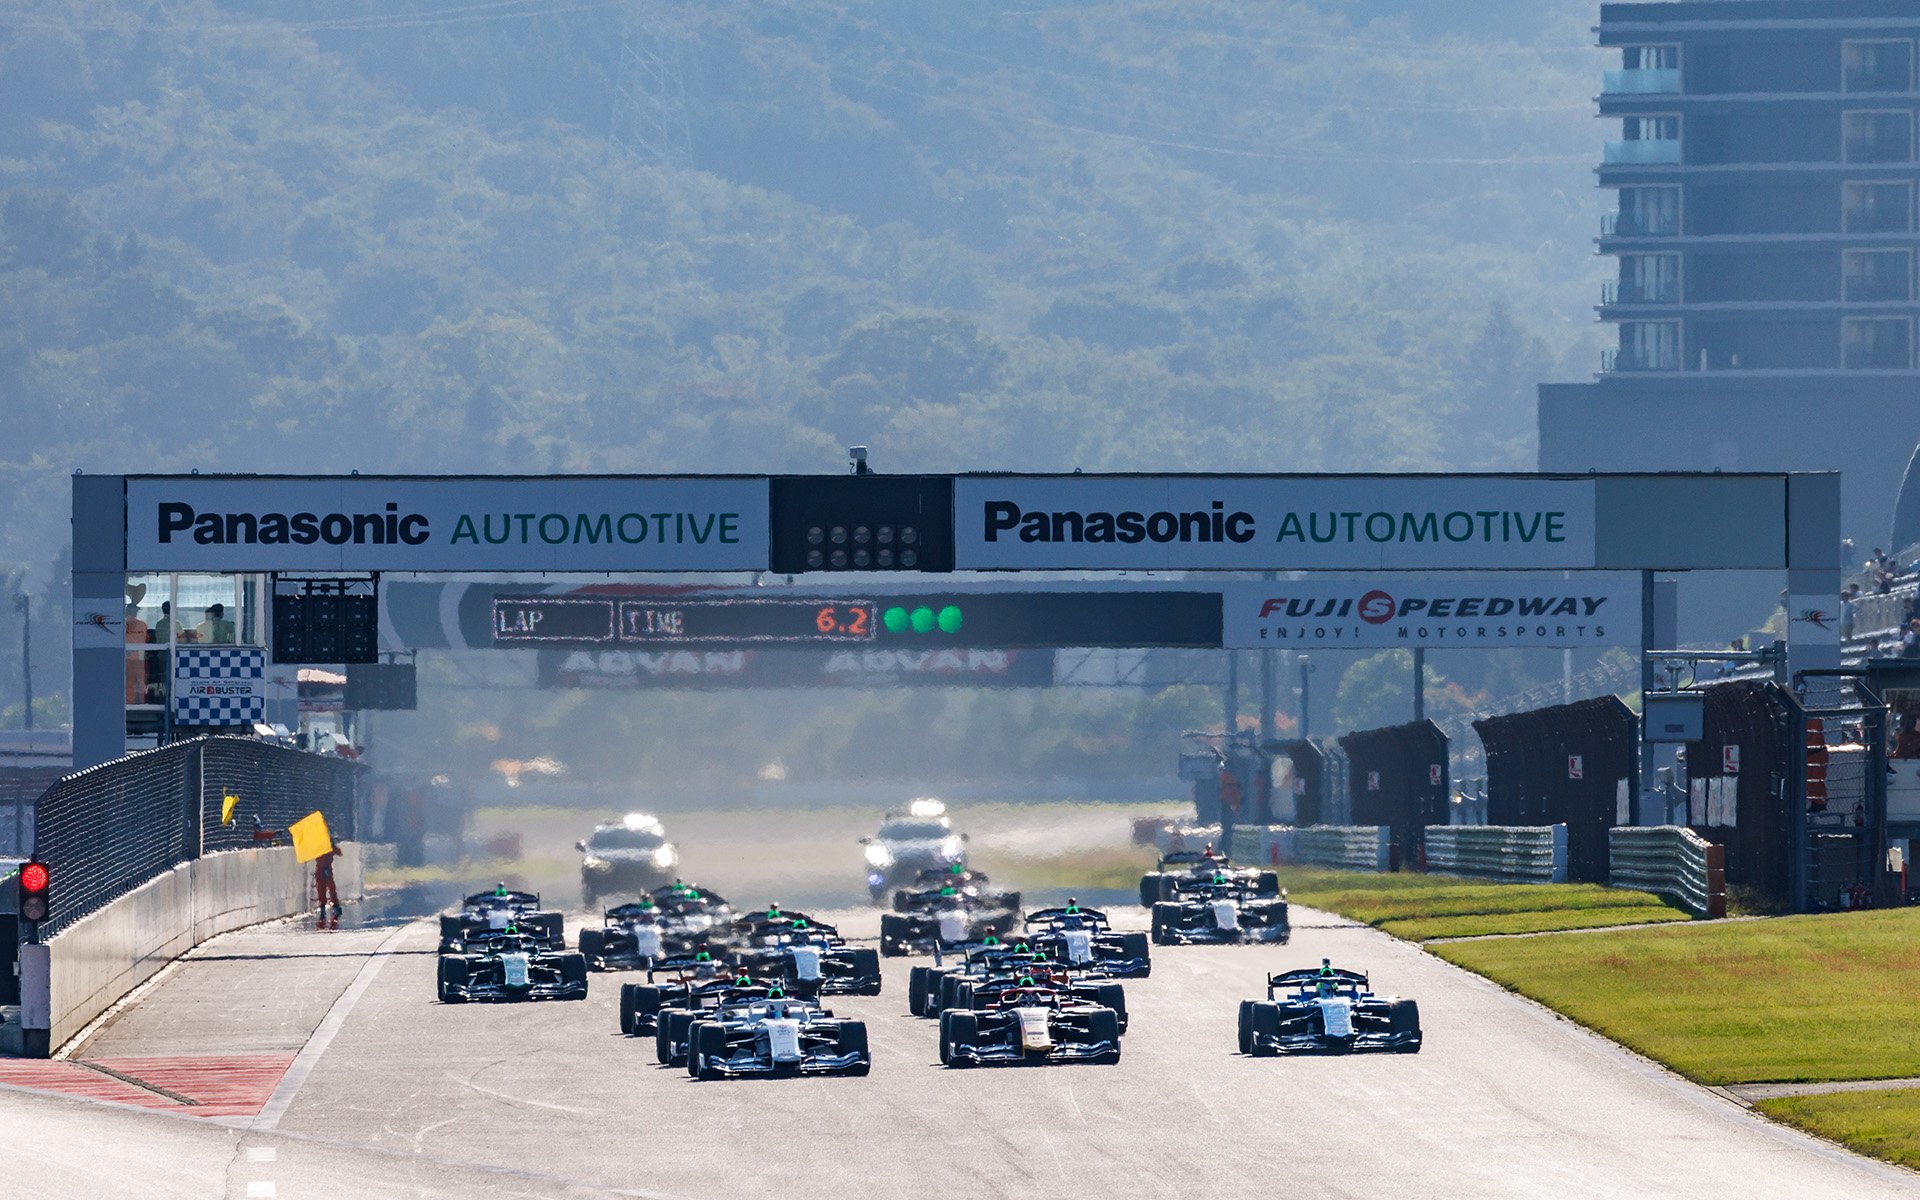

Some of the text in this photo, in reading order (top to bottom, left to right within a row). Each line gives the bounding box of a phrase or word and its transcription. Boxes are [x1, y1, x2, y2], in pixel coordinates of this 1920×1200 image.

[158, 501, 740, 545] Panasonic AUTOMOTIVE
[984, 500, 1566, 544] Panasonic AUTOMOTIVE
[1258, 598, 1353, 618] FUJI
[500, 610, 544, 632] LAP
[625, 610, 684, 634] TIME
[816, 607, 868, 635] 6.2
[1260, 625, 1606, 640] ENJOY! MOTORSPORTS
[215, 686, 253, 695] BUSTER
